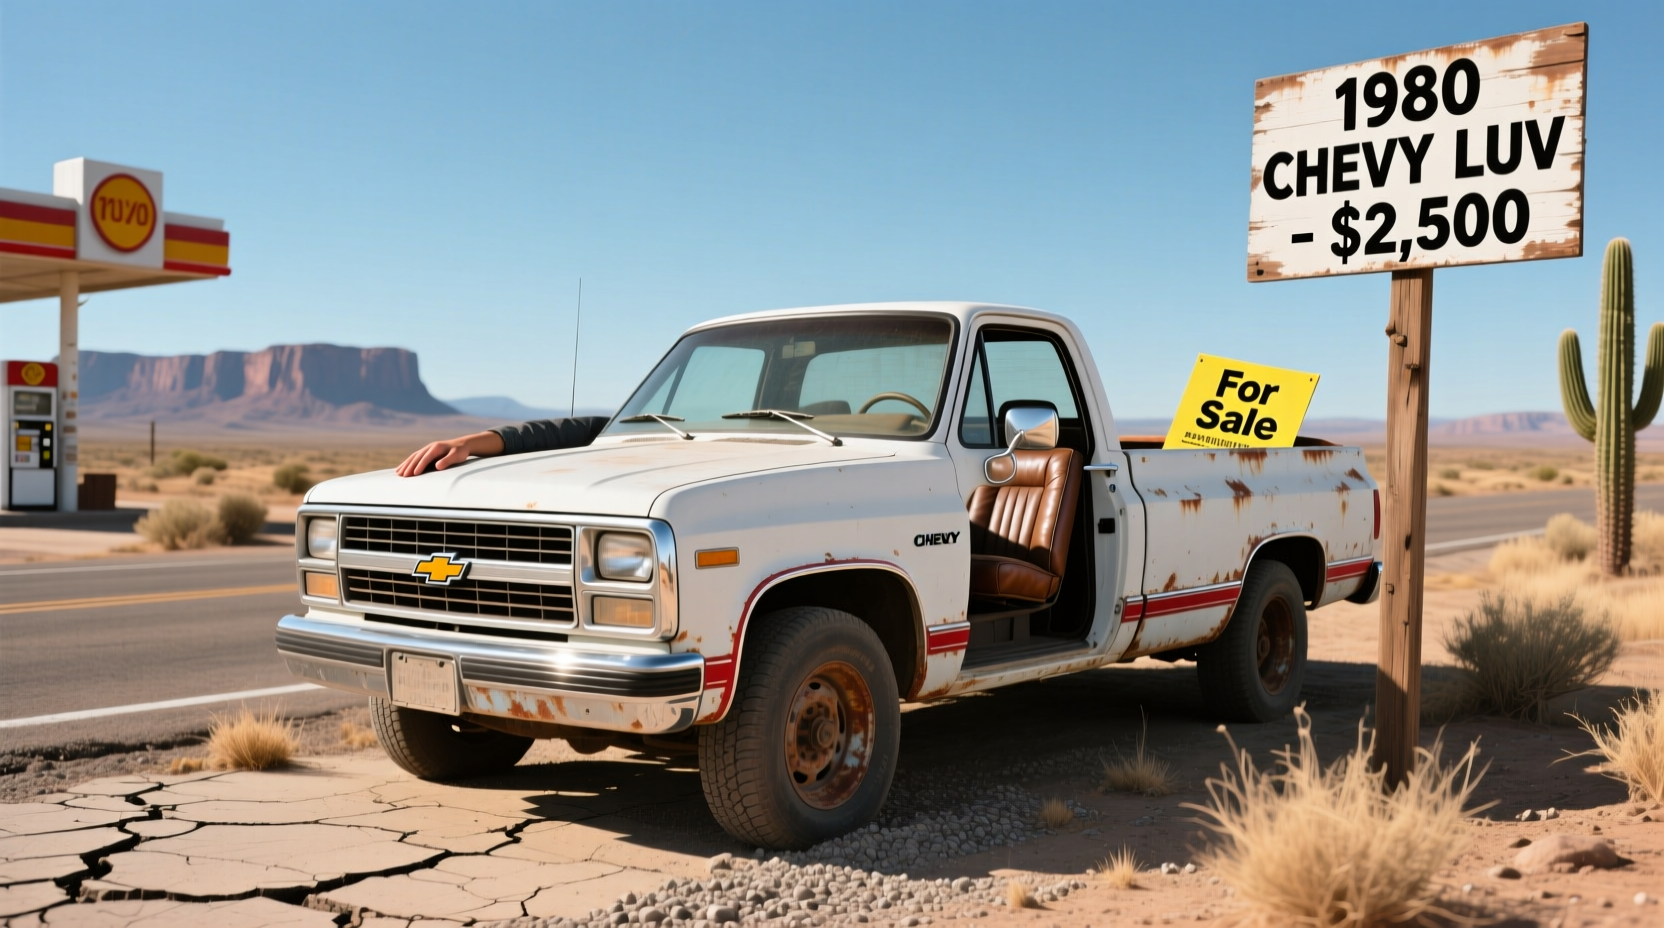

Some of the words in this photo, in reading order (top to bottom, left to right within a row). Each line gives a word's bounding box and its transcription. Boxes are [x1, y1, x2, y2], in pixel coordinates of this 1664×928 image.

[1335, 58, 1480, 131] 1980
[1263, 133, 1435, 200] CHEVY
[1455, 115, 1566, 179] LUV
[1330, 188, 1530, 265] $2,500
[1196, 400, 1278, 440] Sale
[1216, 369, 1280, 405] For
